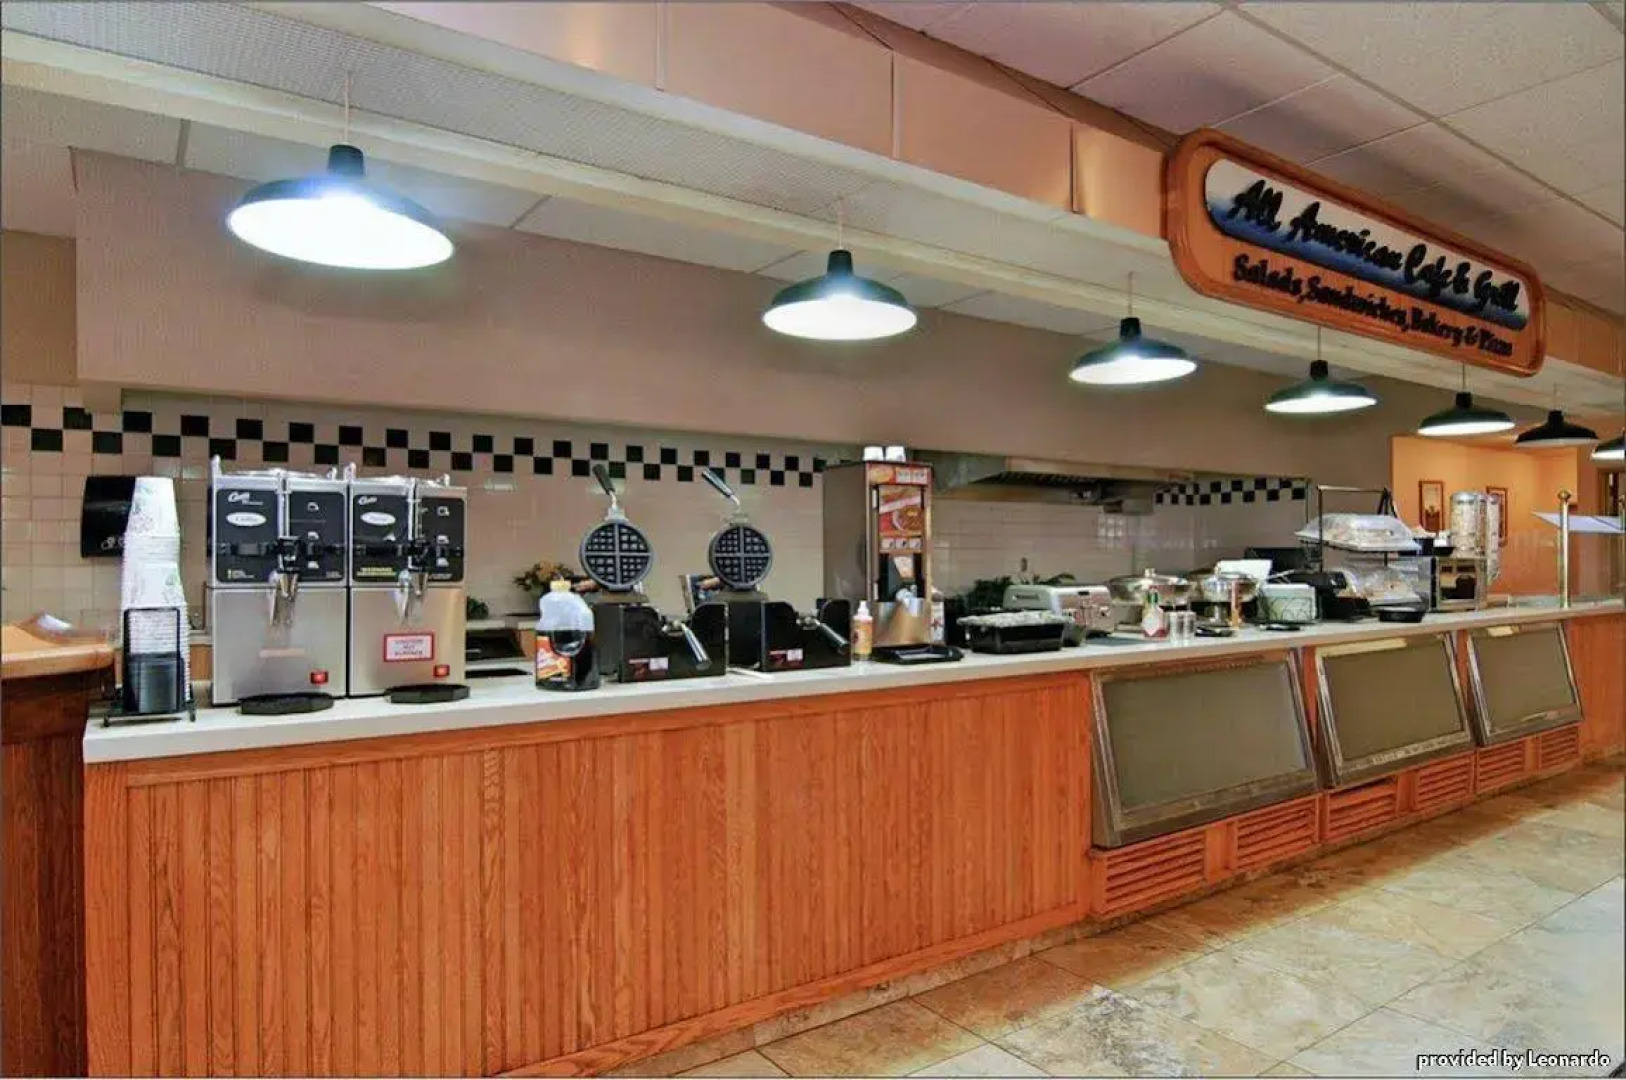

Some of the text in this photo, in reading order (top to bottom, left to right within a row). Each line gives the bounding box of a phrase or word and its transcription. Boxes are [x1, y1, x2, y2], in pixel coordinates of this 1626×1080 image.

[1227, 179, 1283, 232] All
[1281, 201, 1402, 271] American
[1452, 262, 1471, 294] &
[1473, 269, 1520, 312] Grill
